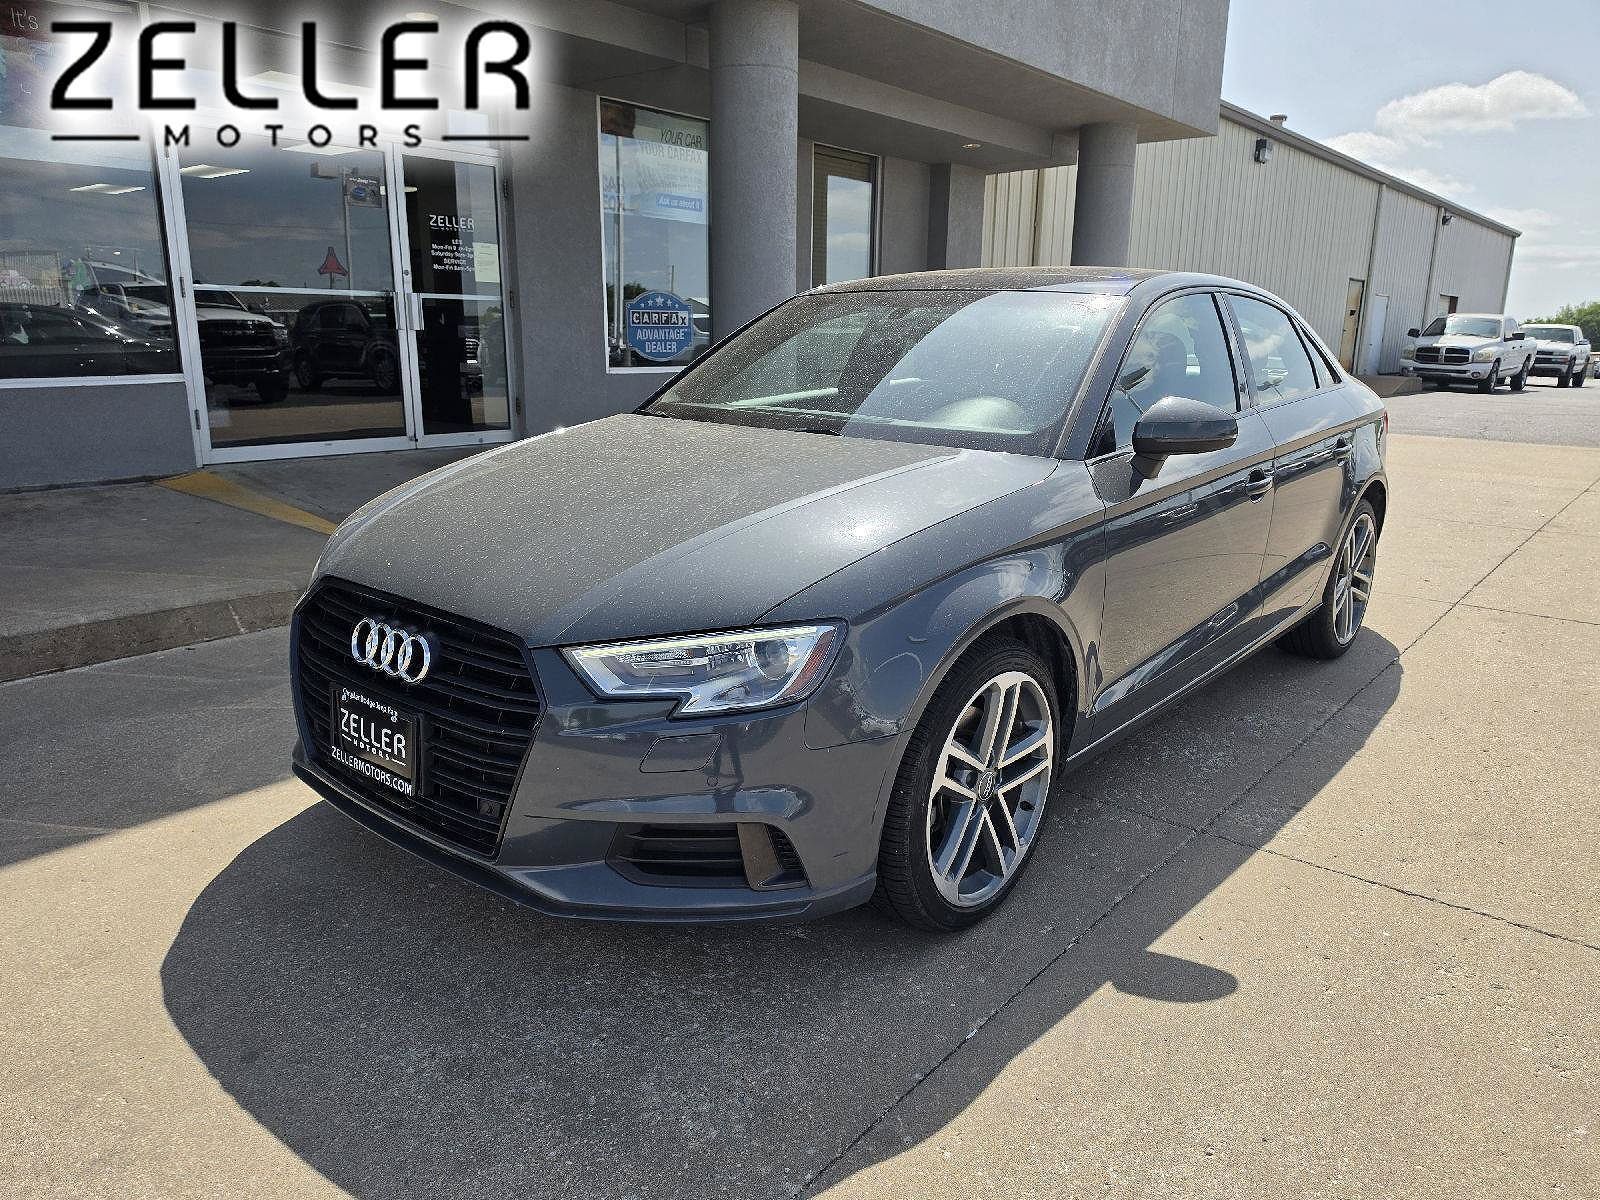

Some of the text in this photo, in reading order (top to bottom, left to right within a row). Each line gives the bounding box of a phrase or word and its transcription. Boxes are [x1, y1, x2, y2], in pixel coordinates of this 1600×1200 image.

[10, 8, 39, 30] It's
[660, 128, 702, 149] YOUR CAR
[429, 214, 475, 231] ZELLER
[632, 311, 687, 326] CARFAX
[636, 328, 685, 340] ADVANTAGE
[645, 341, 677, 353] DEALER
[340, 707, 406, 759] ZELLER
[353, 738, 390, 760] MOTORS
[331, 745, 413, 797] ZELLERMOTORS.COM
